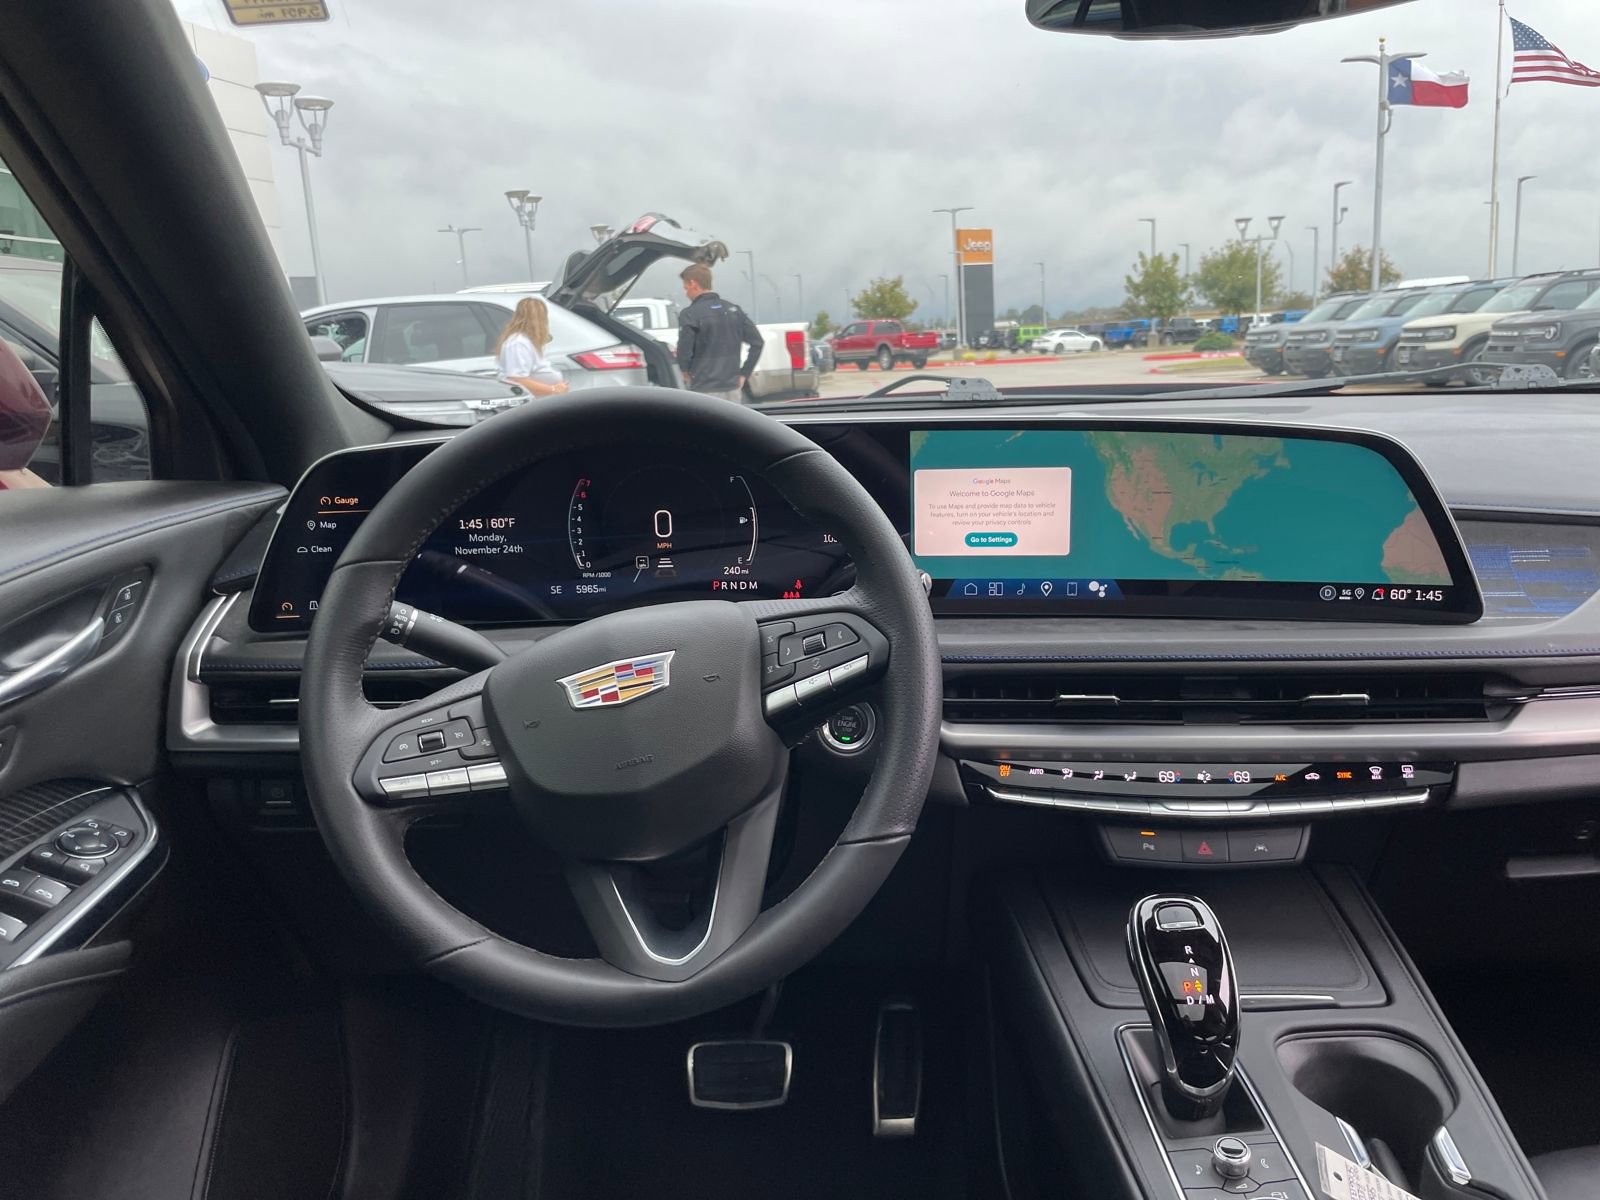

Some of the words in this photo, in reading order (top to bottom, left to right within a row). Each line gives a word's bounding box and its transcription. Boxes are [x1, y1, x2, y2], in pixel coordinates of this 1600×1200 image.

[965, 238, 991, 253] Jeep
[972, 478, 993, 486] Google
[995, 478, 1011, 486] Maps
[949, 490, 980, 498] Welcome
[981, 490, 988, 498] to
[990, 490, 1015, 499] Google
[1016, 489, 1035, 499] Maps
[334, 496, 359, 506] Gauge
[948, 503, 963, 511] Maps
[320, 521, 337, 530] Map
[459, 518, 483, 529] 1:45
[491, 517, 515, 528] 60°F
[654, 509, 673, 539] 0
[469, 532, 507, 543] Monday,
[823, 534, 838, 543] 10
[988, 536, 1013, 545] Settings
[310, 545, 333, 553] Clean
[455, 545, 501, 555] November
[502, 545, 523, 554] 24th
[656, 542, 673, 550] MPH
[550, 585, 562, 594] SE
[1390, 588, 1412, 601] 60°
[1415, 589, 1443, 602] 1:45
[837, 720, 857, 728] ENGINE
[1159, 770, 1176, 783] 69
[1233, 770, 1251, 783] 69
[1274, 773, 1287, 782] A/C
[1336, 771, 1353, 779] SYNC
[1184, 945, 1194, 955] R
[1190, 967, 1200, 977] N
[1183, 981, 1191, 992] P
